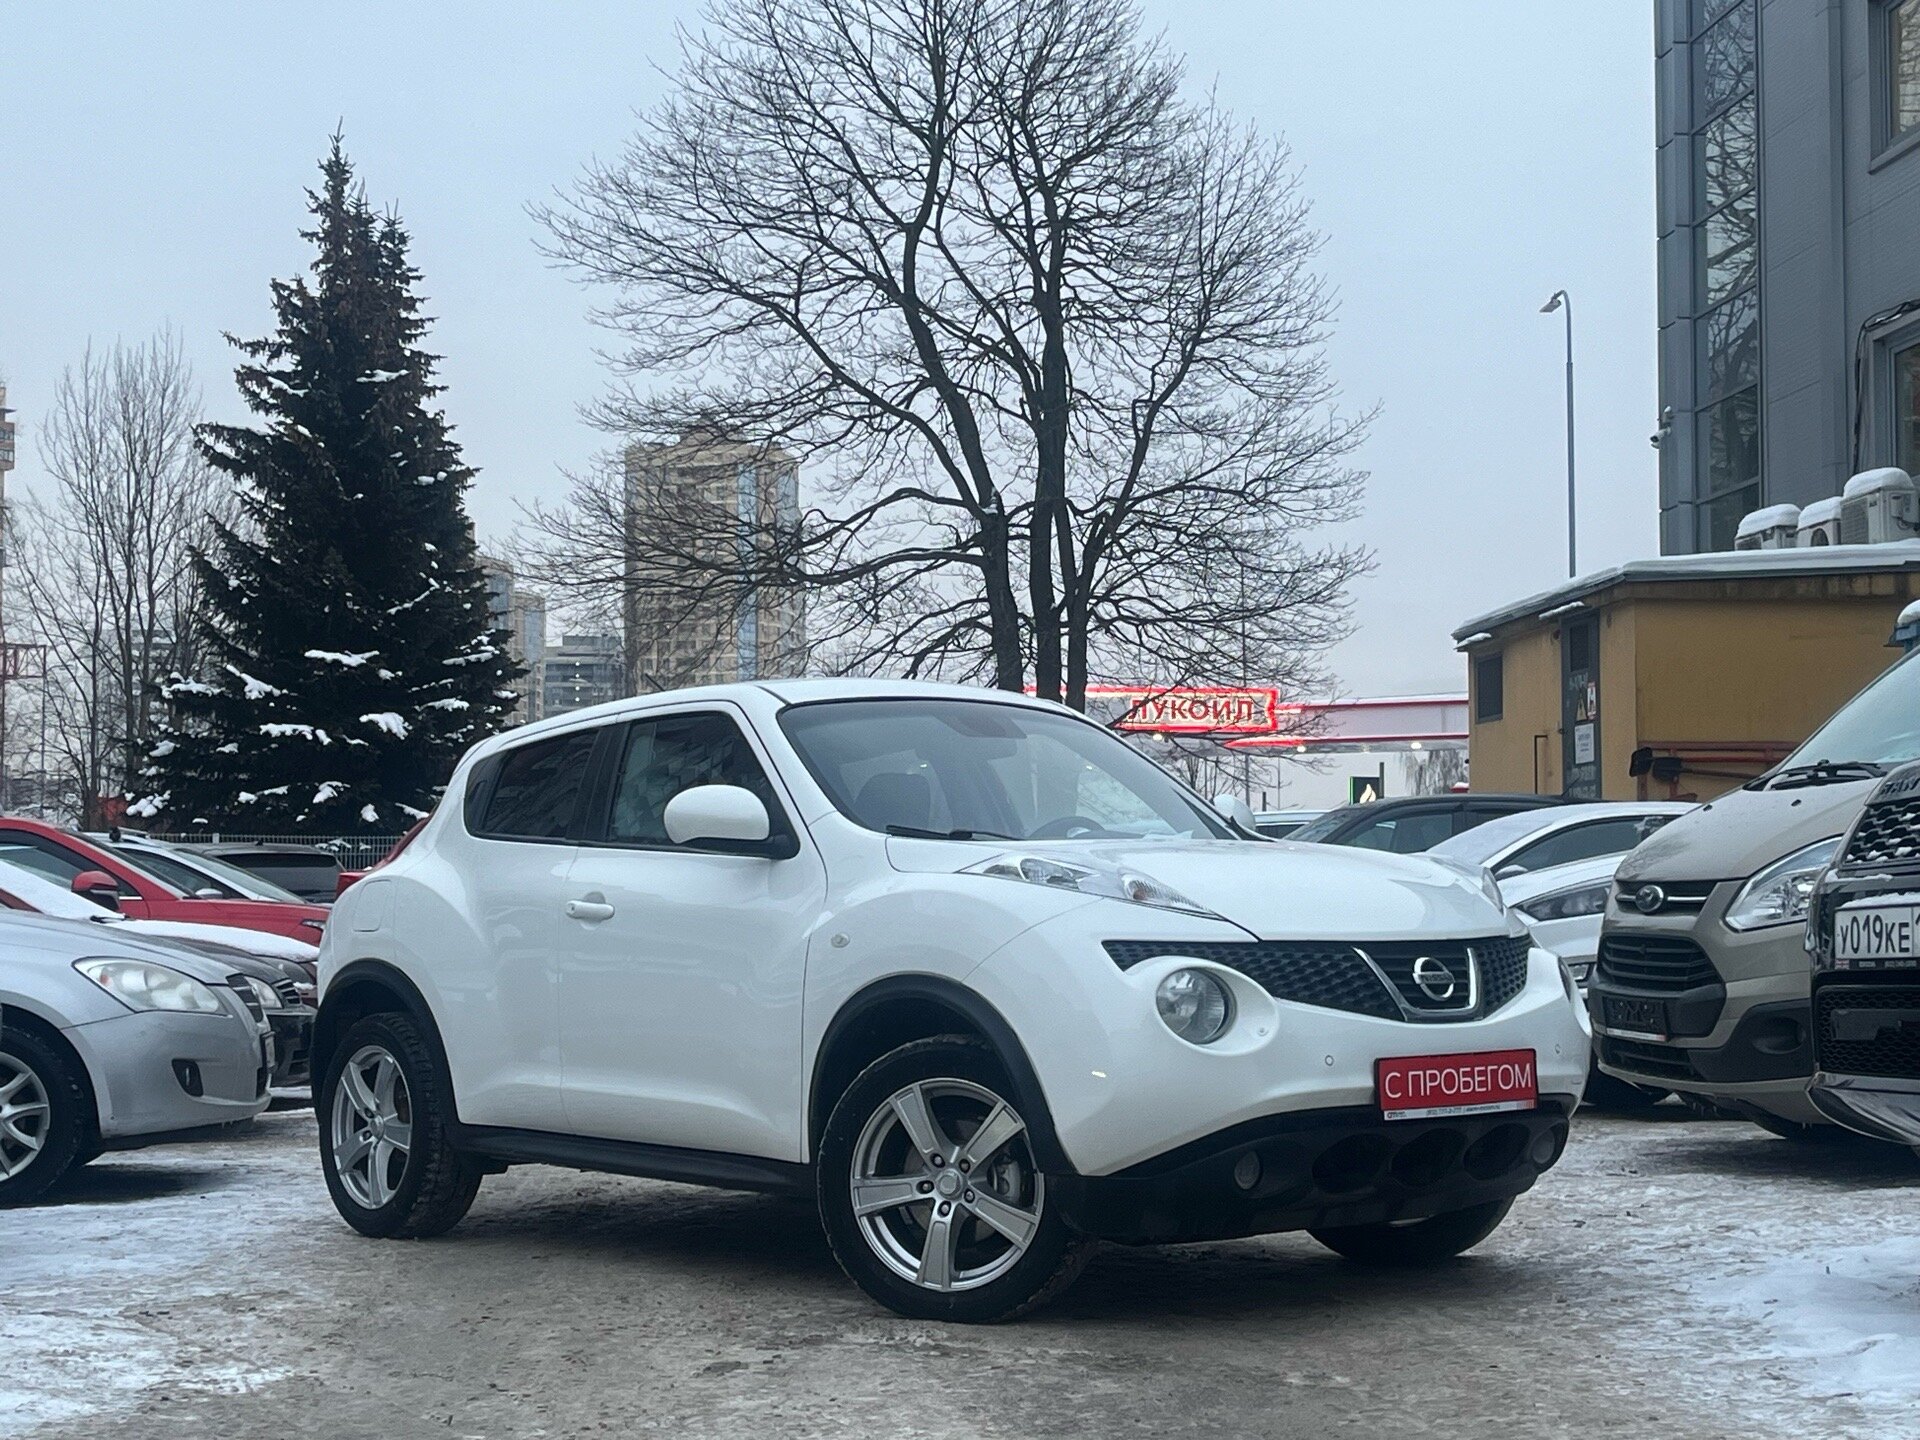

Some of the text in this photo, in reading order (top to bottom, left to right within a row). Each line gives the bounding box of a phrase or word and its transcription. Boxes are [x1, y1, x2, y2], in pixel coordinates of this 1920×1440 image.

[1127, 698, 1253, 721] ЛУКОИЛ
[1385, 1063, 1532, 1098] С ПРОБЕГОМ
